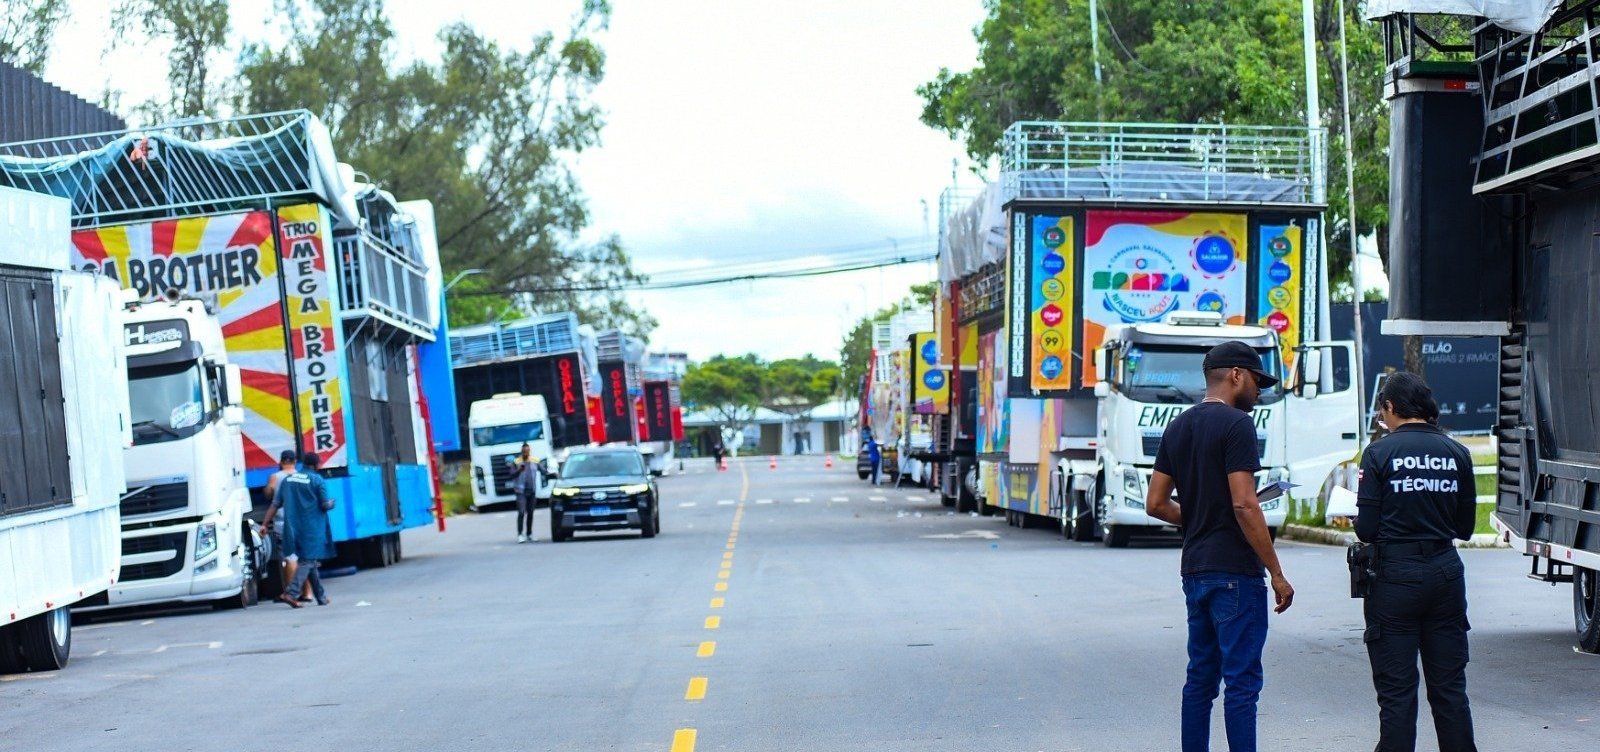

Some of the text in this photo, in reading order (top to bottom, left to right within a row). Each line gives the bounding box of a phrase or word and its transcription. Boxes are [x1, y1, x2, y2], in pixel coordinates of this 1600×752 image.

[283, 222, 316, 238] TRIO
[128, 248, 261, 297] BROTHER
[1112, 293, 1146, 317] NASCEU
[292, 242, 333, 450] MEGA BROTHER
[1045, 336, 1058, 347] 99
[1422, 341, 1452, 355] EILÃO
[1427, 354, 1457, 364] HARAS
[1458, 353, 1465, 363] 2
[1393, 454, 1458, 471] POLÍCIA
[1390, 476, 1459, 493] TÉCNICA
